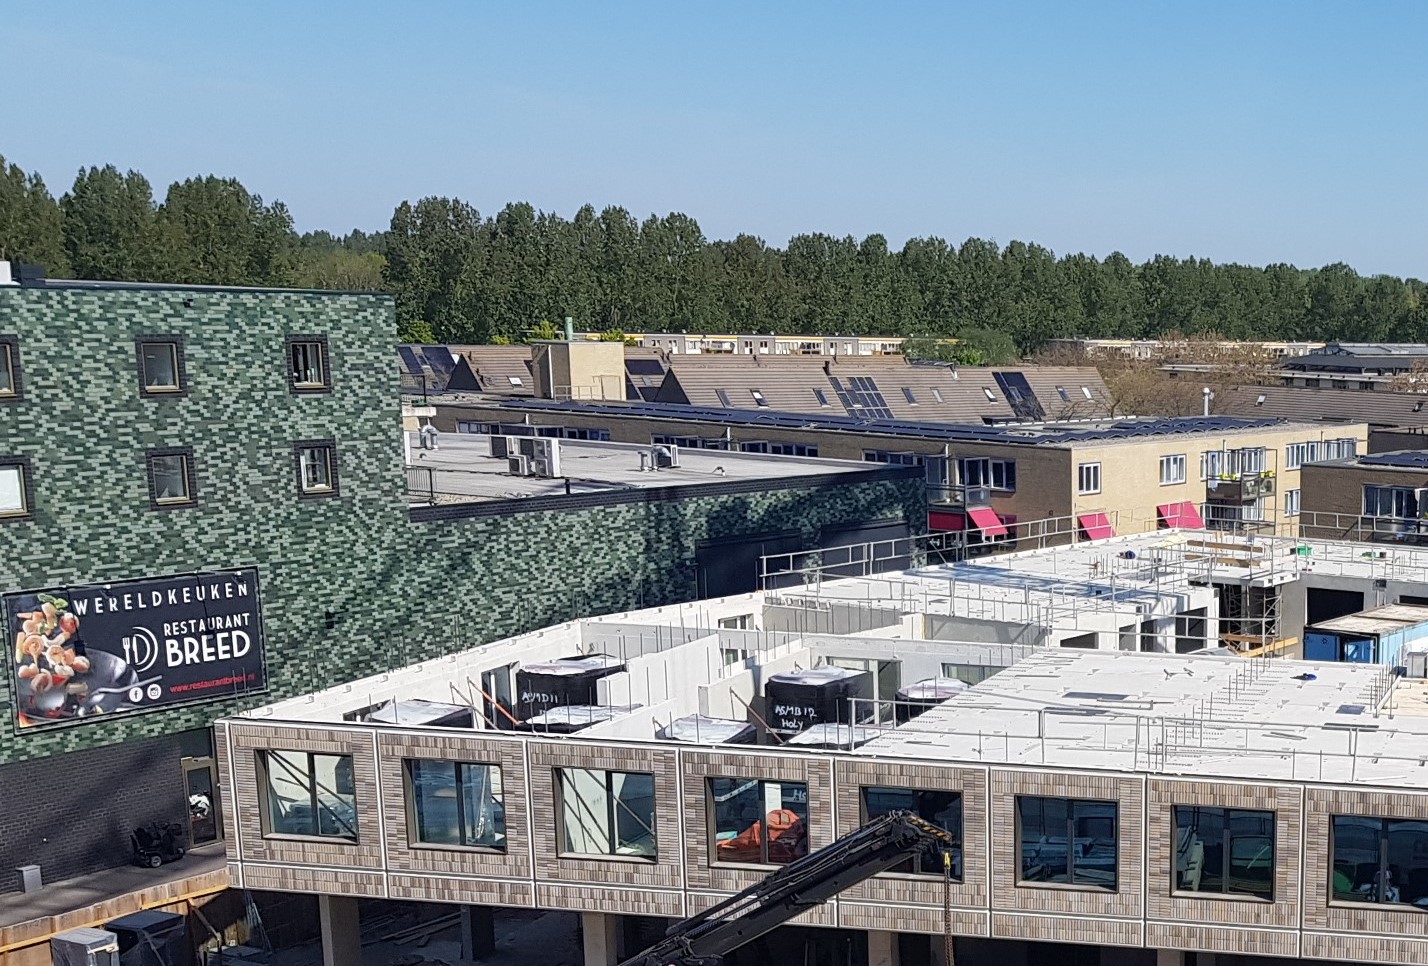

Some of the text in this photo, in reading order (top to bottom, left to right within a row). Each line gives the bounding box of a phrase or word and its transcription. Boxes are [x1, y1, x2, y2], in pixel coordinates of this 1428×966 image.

[74, 580, 249, 615] WERELDKEUKEN
[163, 612, 250, 636] RESTAURANT
[165, 629, 250, 668] BREED
